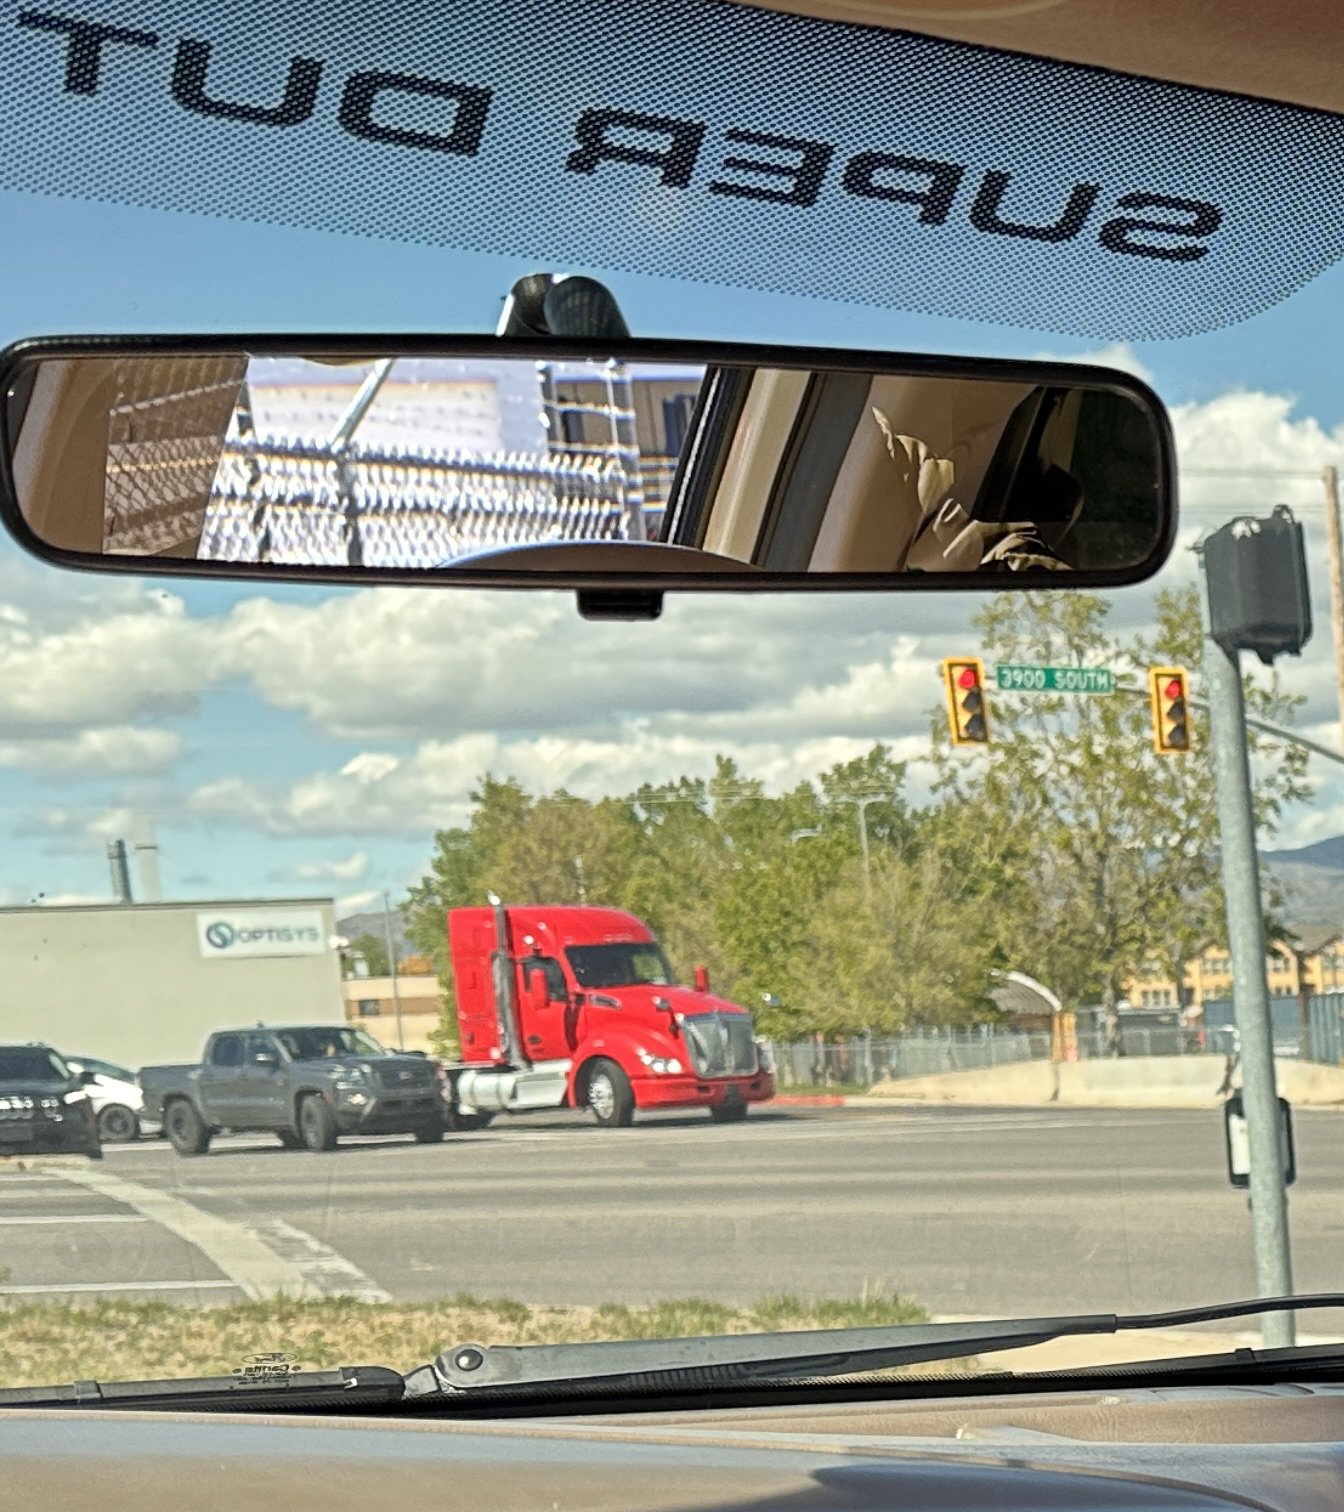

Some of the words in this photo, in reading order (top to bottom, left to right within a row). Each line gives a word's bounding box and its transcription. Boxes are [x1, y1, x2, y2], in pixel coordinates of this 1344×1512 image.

[1001, 669, 1046, 689] 3900
[1054, 671, 1110, 691] SOUTH
[237, 926, 320, 943] OPTISYS
